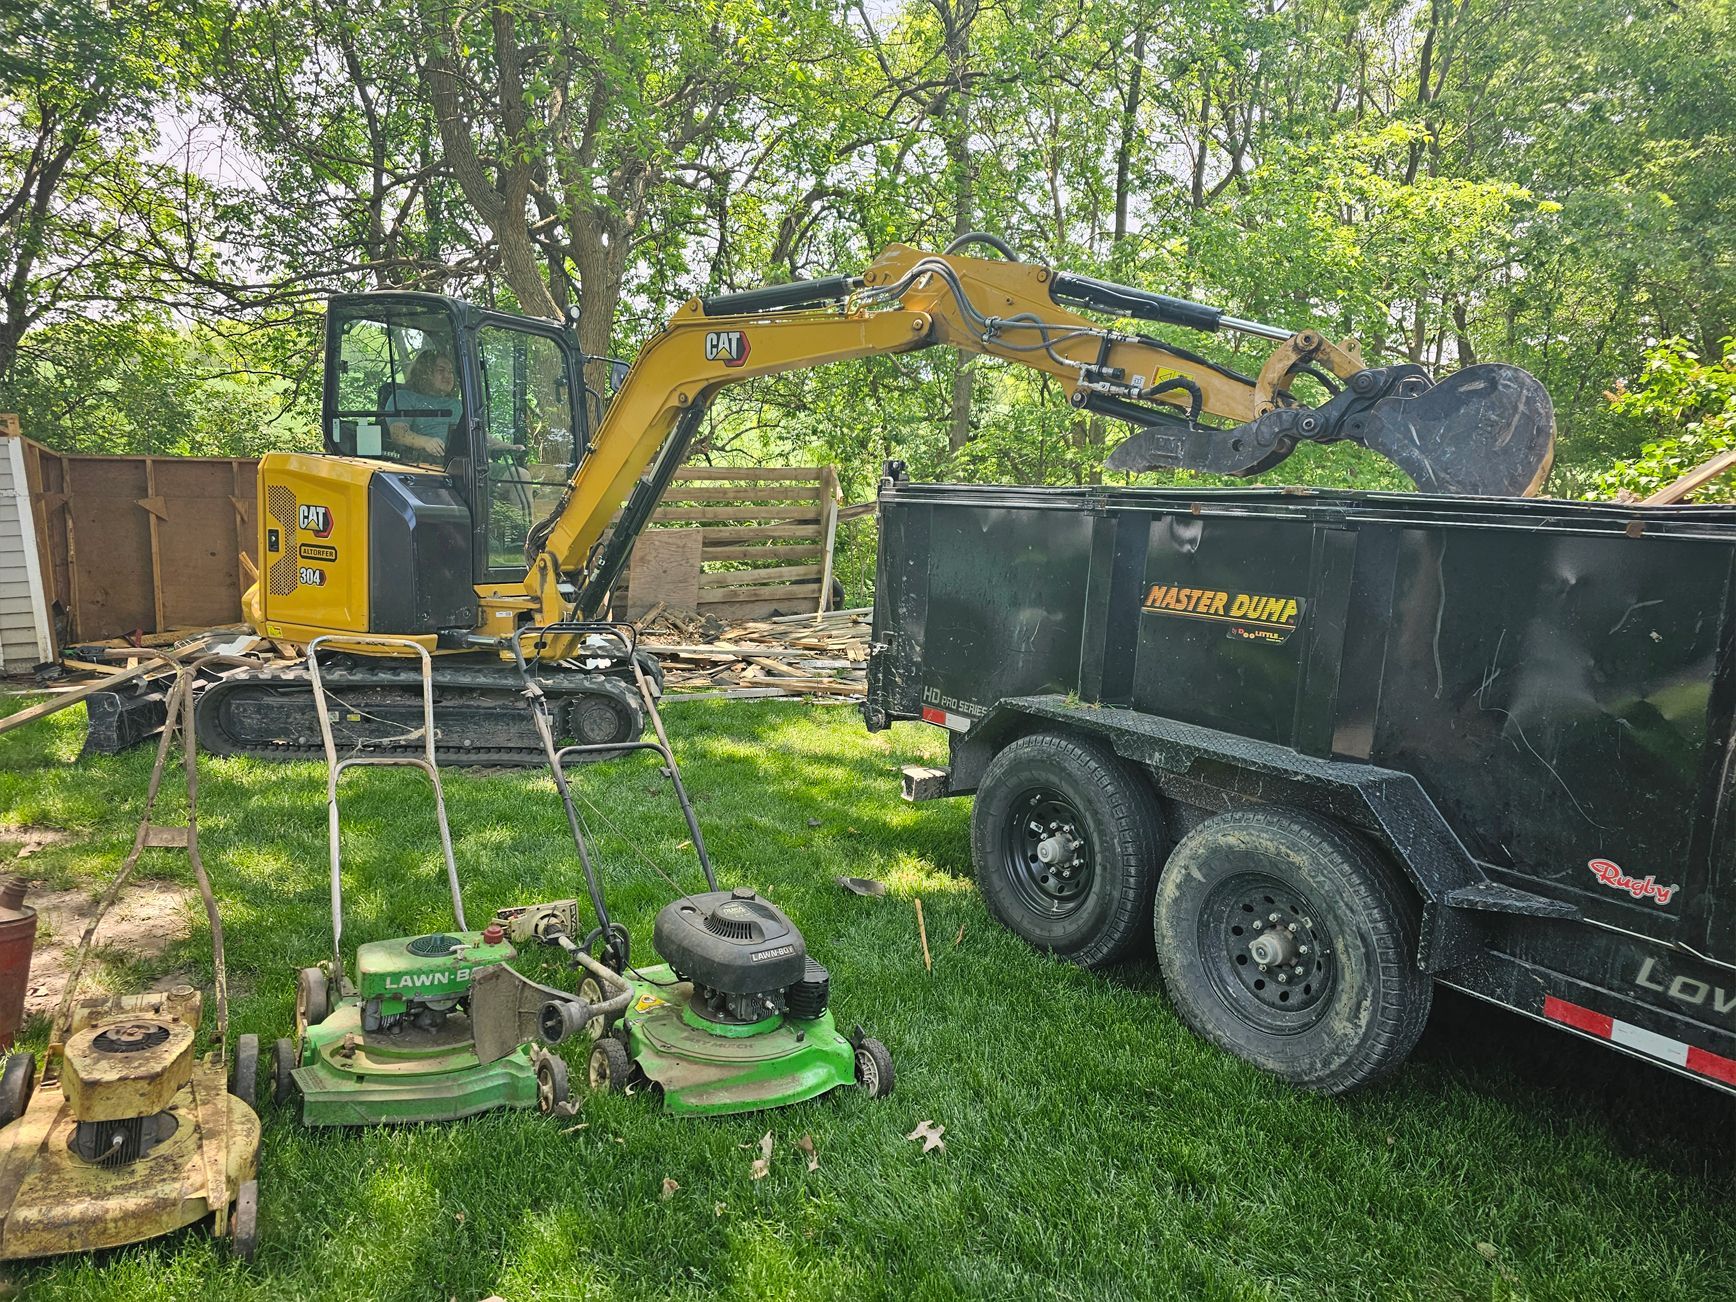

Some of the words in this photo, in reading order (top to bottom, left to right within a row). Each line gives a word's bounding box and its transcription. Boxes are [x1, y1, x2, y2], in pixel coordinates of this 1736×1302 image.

[706, 332, 740, 360] CAT
[299, 505, 326, 531] CAT
[302, 548, 334, 558] ALTORFER
[300, 567, 321, 586] 304
[1145, 585, 1228, 615] MASTER
[1229, 594, 1297, 623] DUMP
[923, 685, 941, 704] HD
[941, 696, 958, 709] PRO
[958, 700, 988, 717] SERIES
[1589, 860, 1672, 903] Rugby
[751, 945, 796, 961] LAWN-BOY
[385, 965, 483, 989] LAWN-B
